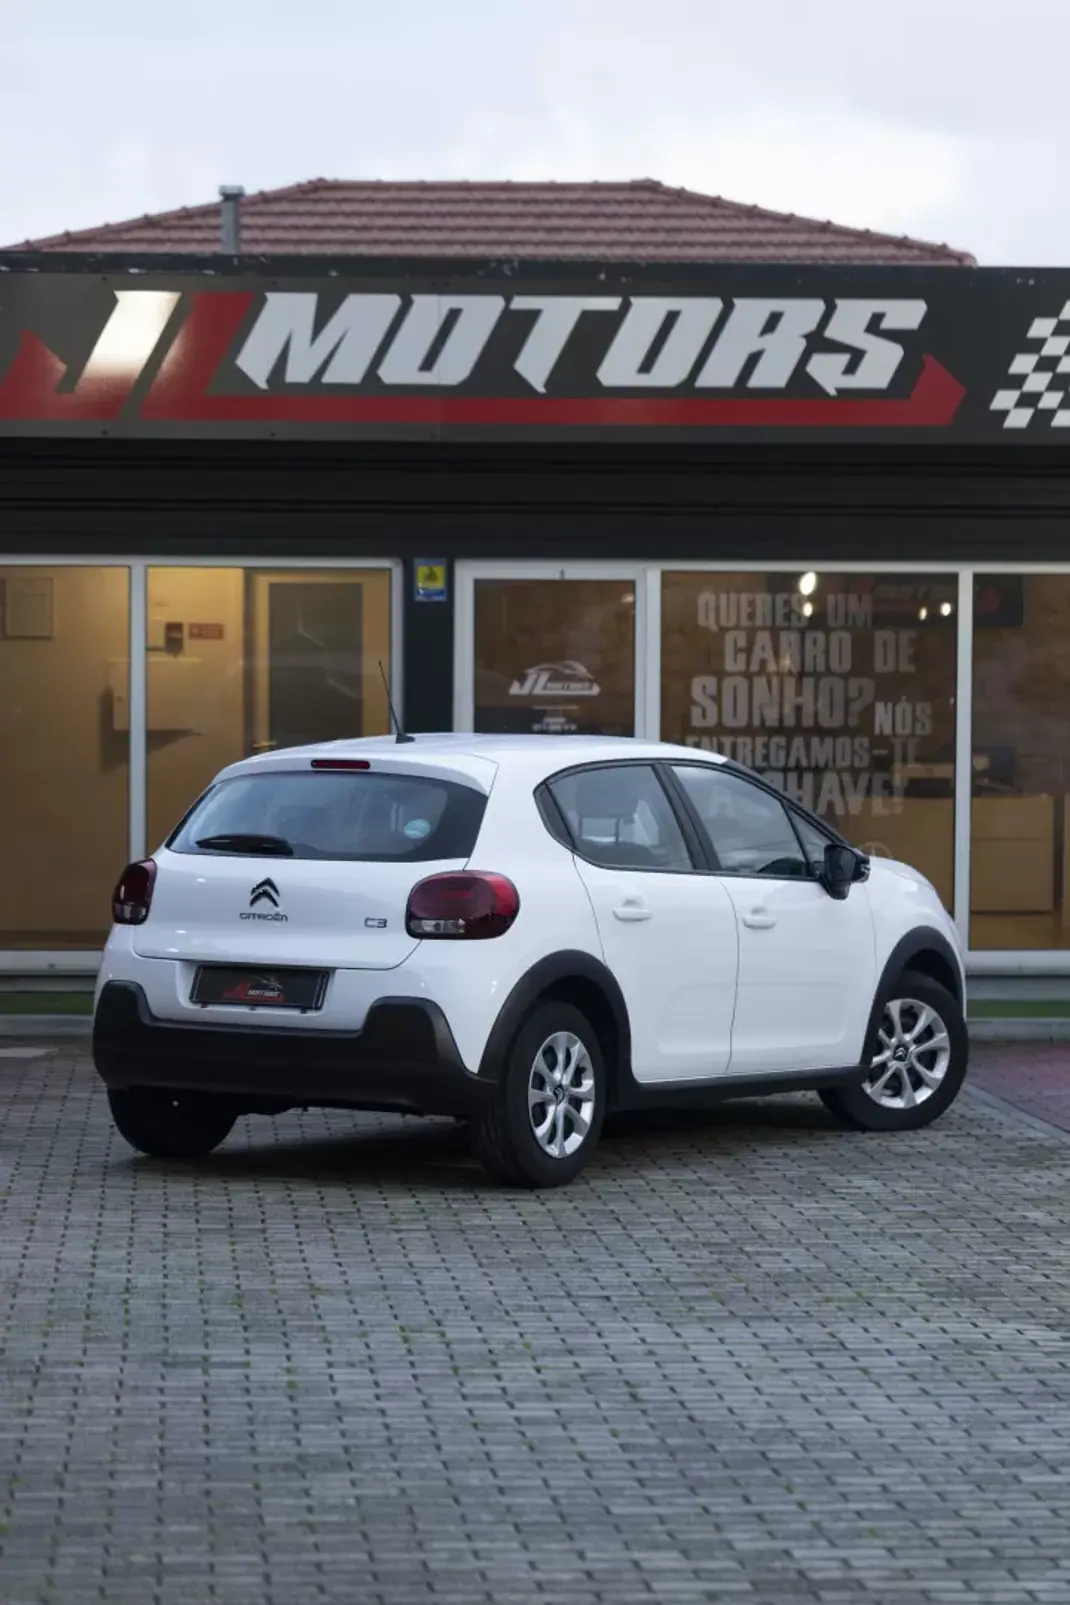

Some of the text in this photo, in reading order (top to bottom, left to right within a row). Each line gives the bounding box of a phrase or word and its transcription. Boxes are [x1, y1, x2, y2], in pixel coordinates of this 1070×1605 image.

[235, 292, 928, 397] MOTORS
[697, 592, 809, 632] QUERES
[826, 593, 873, 628] UM
[724, 630, 917, 673] CARRO DE
[690, 676, 933, 737] SONHO? NÓS
[364, 917, 388, 929] C3
